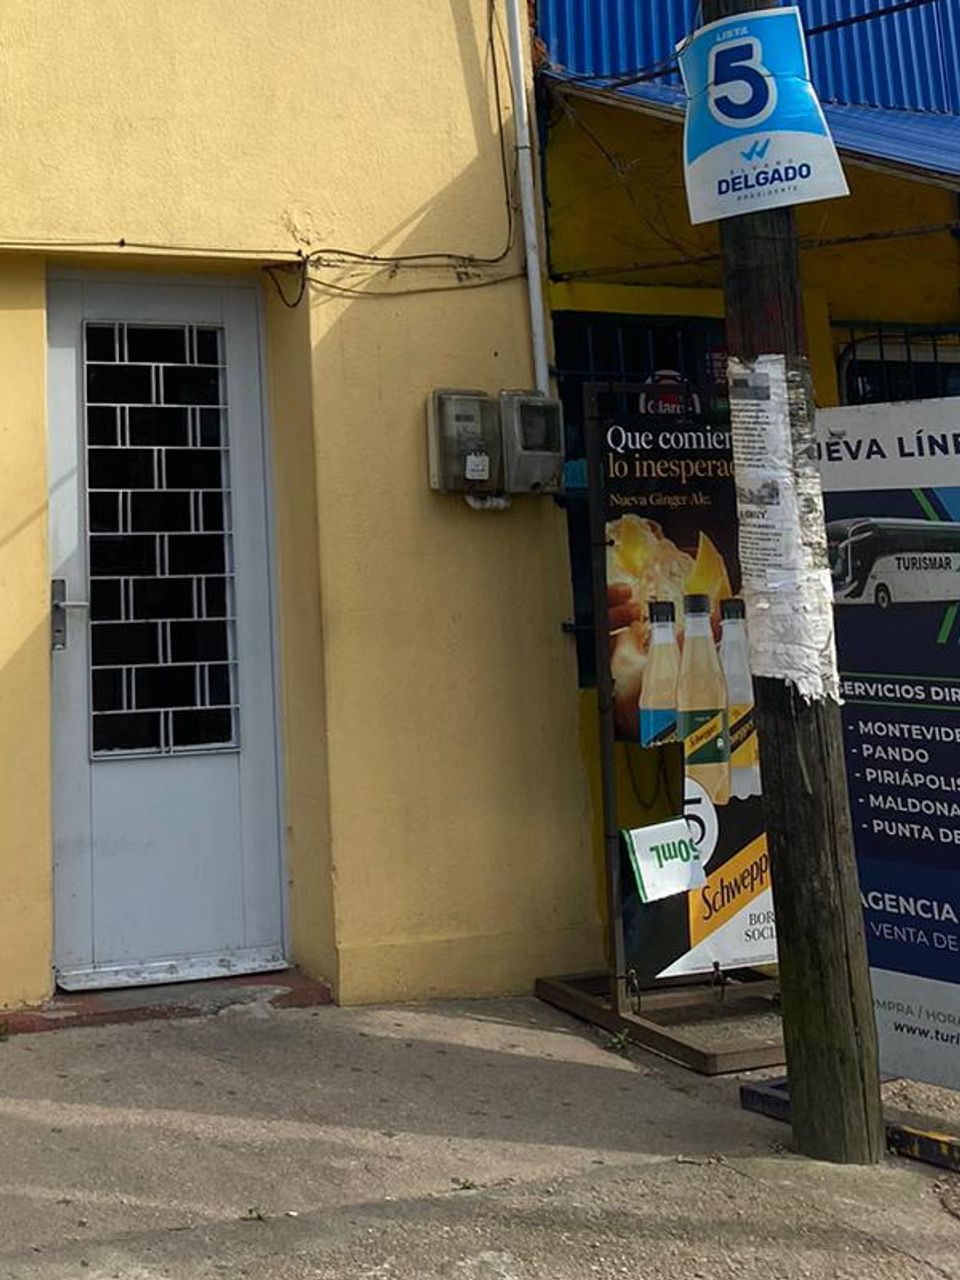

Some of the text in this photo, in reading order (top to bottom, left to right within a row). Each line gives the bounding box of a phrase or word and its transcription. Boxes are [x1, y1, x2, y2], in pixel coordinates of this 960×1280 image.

[711, 40, 773, 122] 5
[717, 163, 811, 195] DELGADO
[607, 425, 653, 453] Que
[608, 452, 628, 478] lo
[895, 556, 952, 570] TURISMAR
[863, 744, 929, 763] PANDO
[873, 819, 935, 841] PUNTA
[871, 921, 959, 952] VENTA DE
[926, 1008, 960, 1025] HOR
